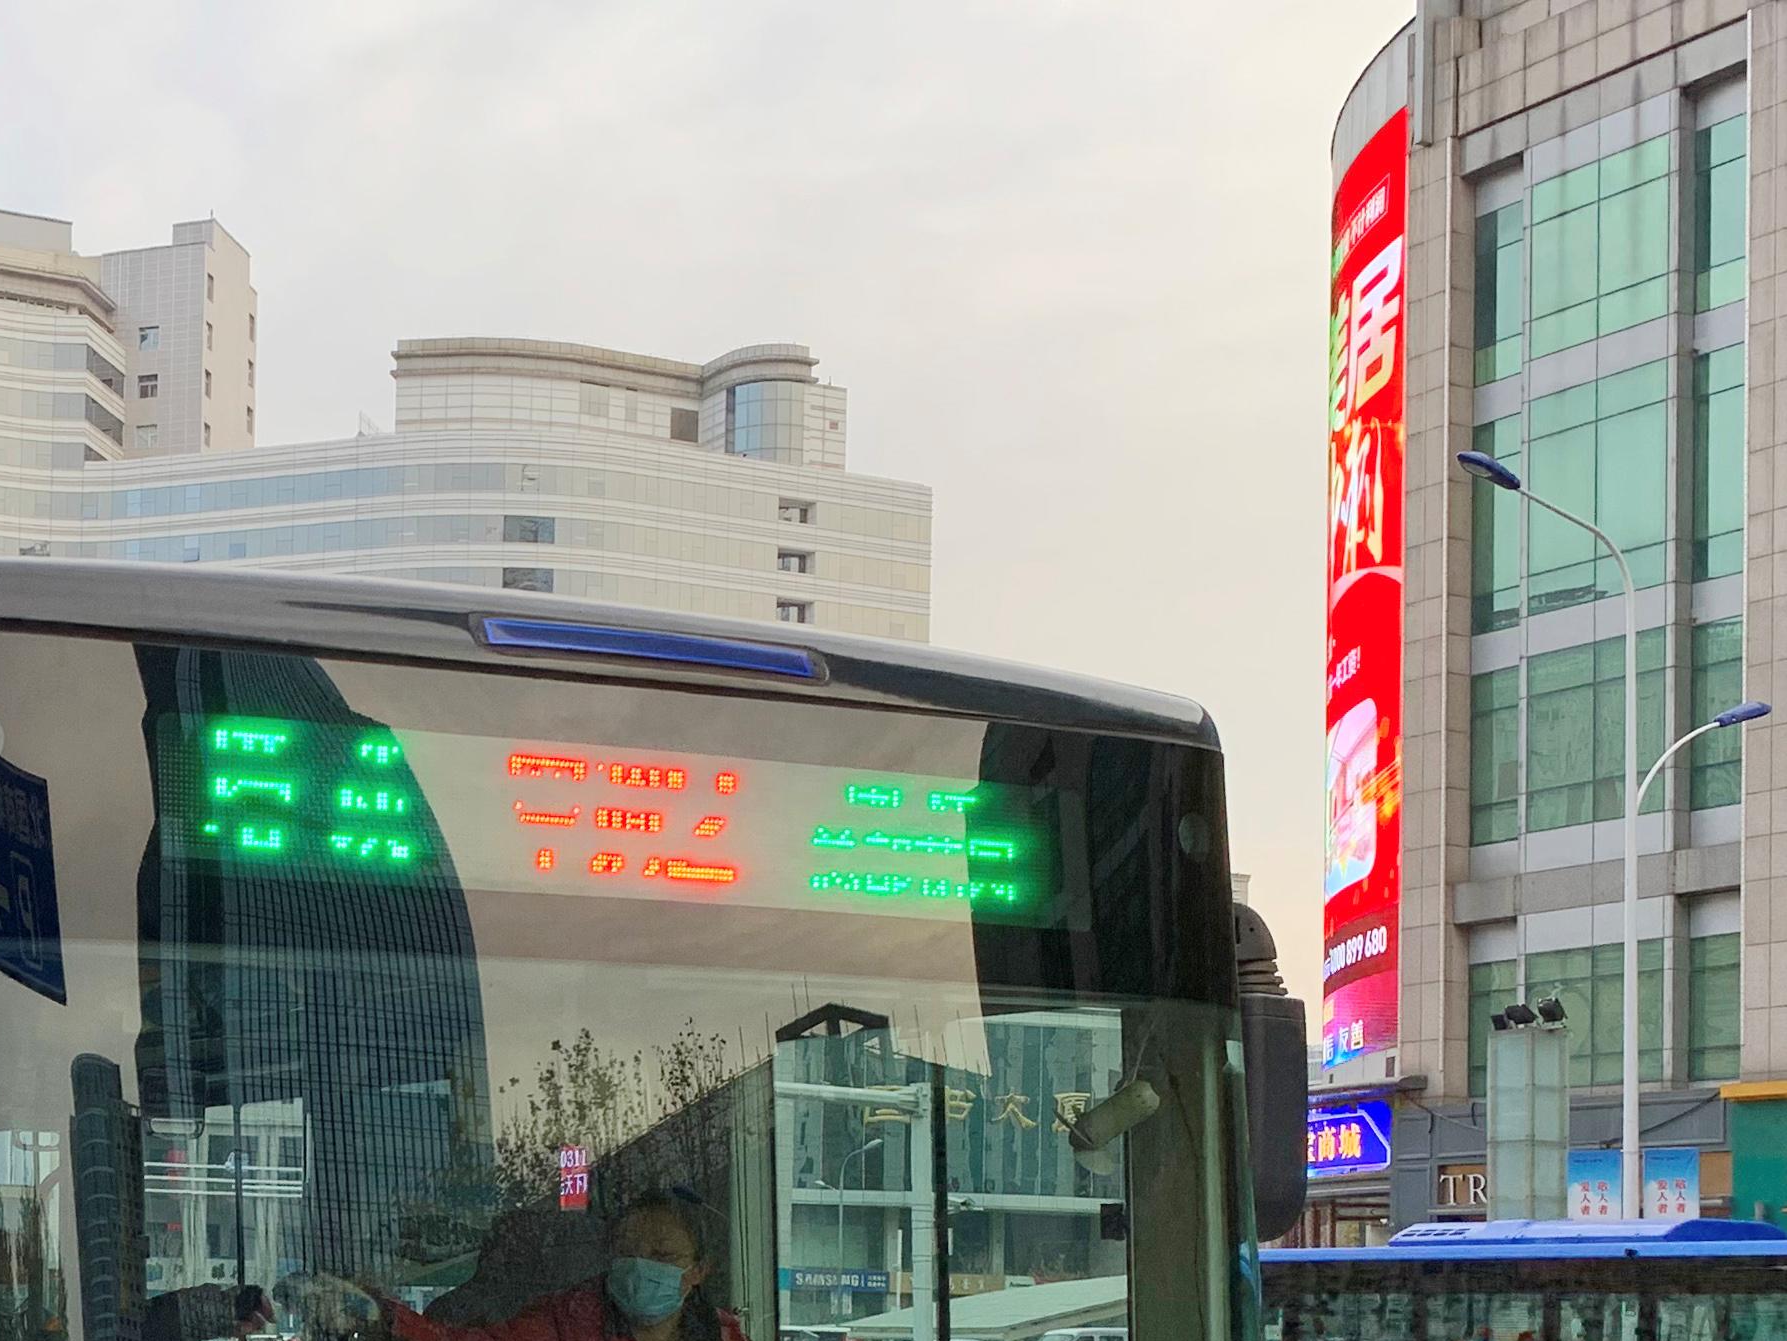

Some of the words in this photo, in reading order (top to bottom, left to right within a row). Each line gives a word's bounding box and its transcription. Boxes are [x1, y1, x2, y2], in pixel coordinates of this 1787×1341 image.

[1346, 934, 1364, 966] 899
[1364, 925, 1388, 958] 680
[1339, 1020, 1364, 1053] 友善
